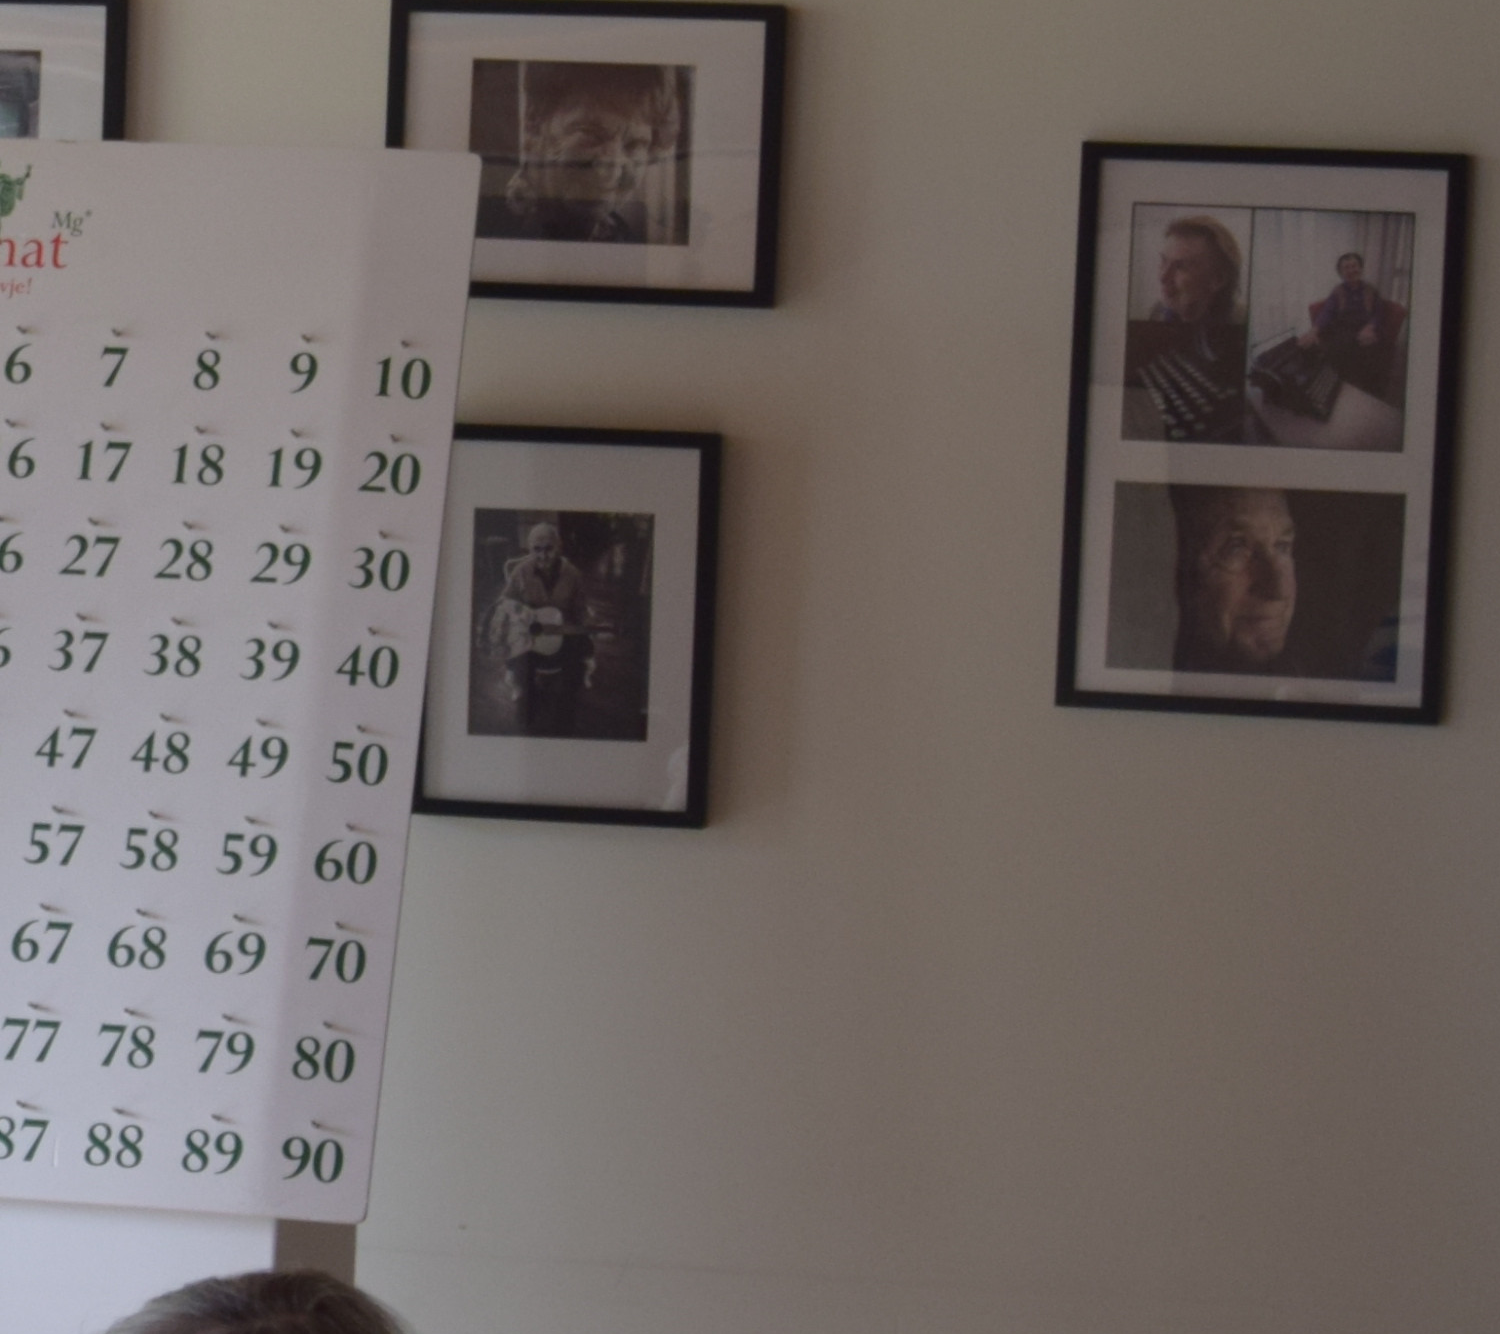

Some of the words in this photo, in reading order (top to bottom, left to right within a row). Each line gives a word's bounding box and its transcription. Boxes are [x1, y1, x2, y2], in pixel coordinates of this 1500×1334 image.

[3, 343, 33, 385] 6
[102, 345, 129, 388] 7
[192, 348, 221, 391] 8
[289, 351, 319, 394] 9
[375, 356, 432, 400] 10
[79, 440, 133, 483] 17
[172, 443, 225, 487] 18
[269, 447, 323, 489] 19
[359, 450, 422, 496] 20
[59, 533, 121, 578] 27
[154, 537, 214, 582] 28
[250, 541, 312, 584] 29
[350, 546, 411, 592] 30
[49, 628, 110, 673] 37
[144, 633, 203, 677] 38
[240, 637, 300, 681] 39
[335, 644, 400, 689] 40
[35, 724, 98, 770] 47
[132, 731, 191, 775] 48
[227, 735, 289, 778] 49
[327, 740, 389, 787] 50
[23, 822, 85, 866] 57
[119, 827, 179, 872] 58
[216, 832, 278, 875] 59
[313, 839, 378, 885] 60
[10, 920, 74, 964] 67
[107, 926, 167, 970] 68
[204, 932, 267, 974] 69
[306, 936, 367, 984] 70
[2, 1017, 61, 1061] 77
[99, 1022, 156, 1069] 78
[196, 1029, 255, 1074] 79
[291, 1035, 356, 1084] 80
[84, 1122, 144, 1169] 88
[181, 1130, 244, 1174] 89
[281, 1136, 345, 1184] 90
